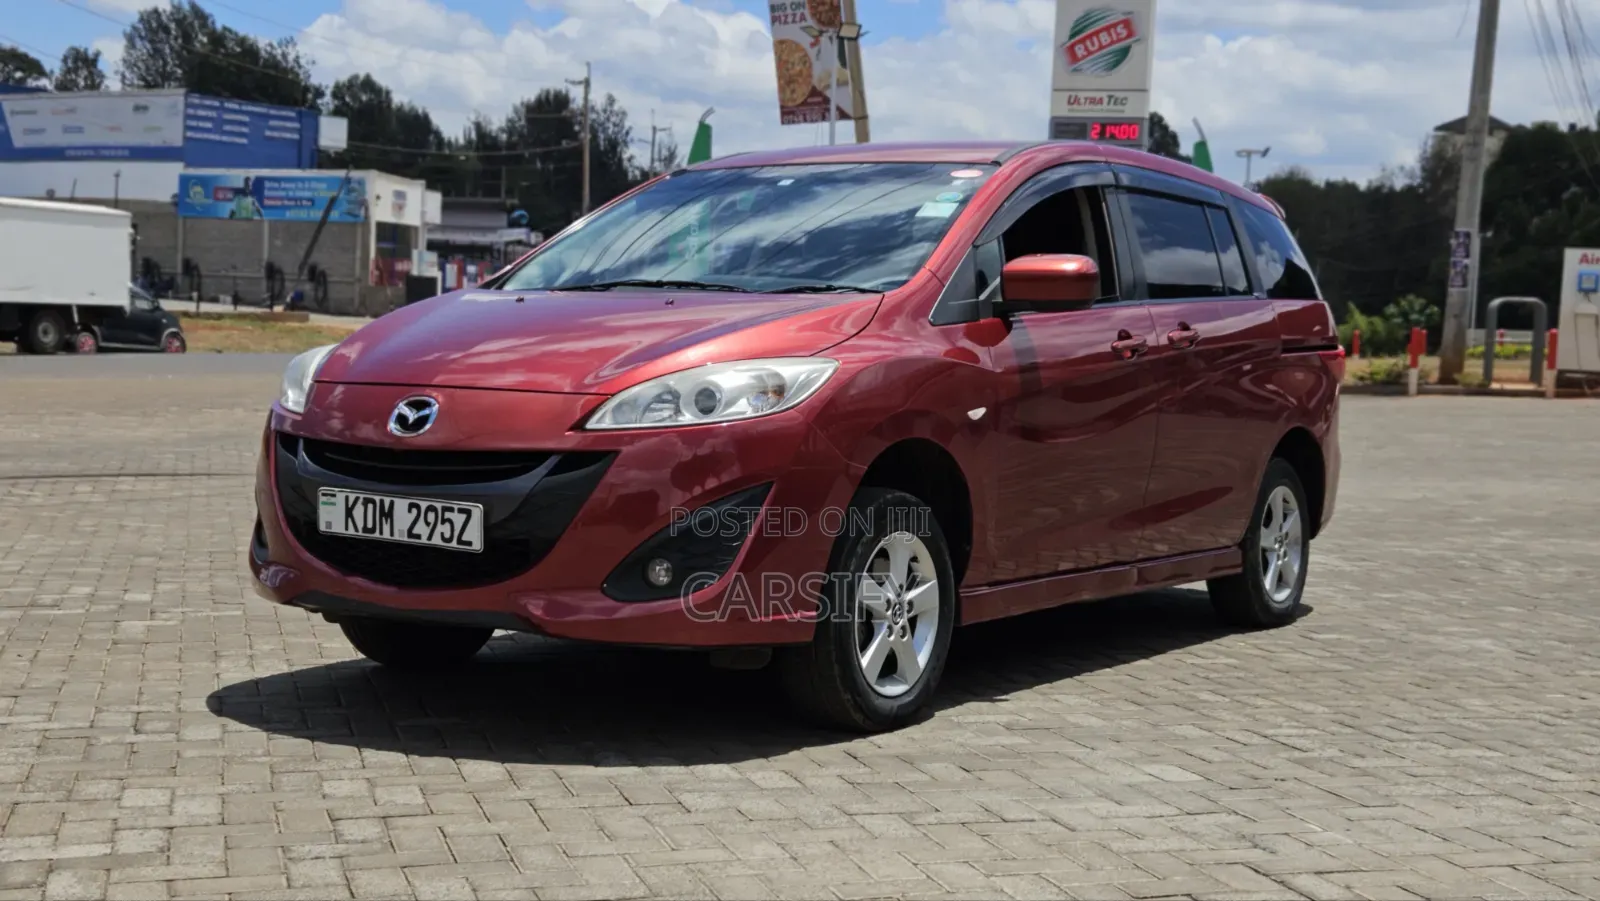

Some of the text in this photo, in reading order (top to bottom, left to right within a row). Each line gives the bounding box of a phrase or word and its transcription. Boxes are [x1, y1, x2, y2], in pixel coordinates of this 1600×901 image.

[769, 2, 787, 13] BIG
[771, 12, 807, 25] PIZZA
[1073, 23, 1129, 60] RUBIS
[344, 495, 473, 547] KDM 295Z
